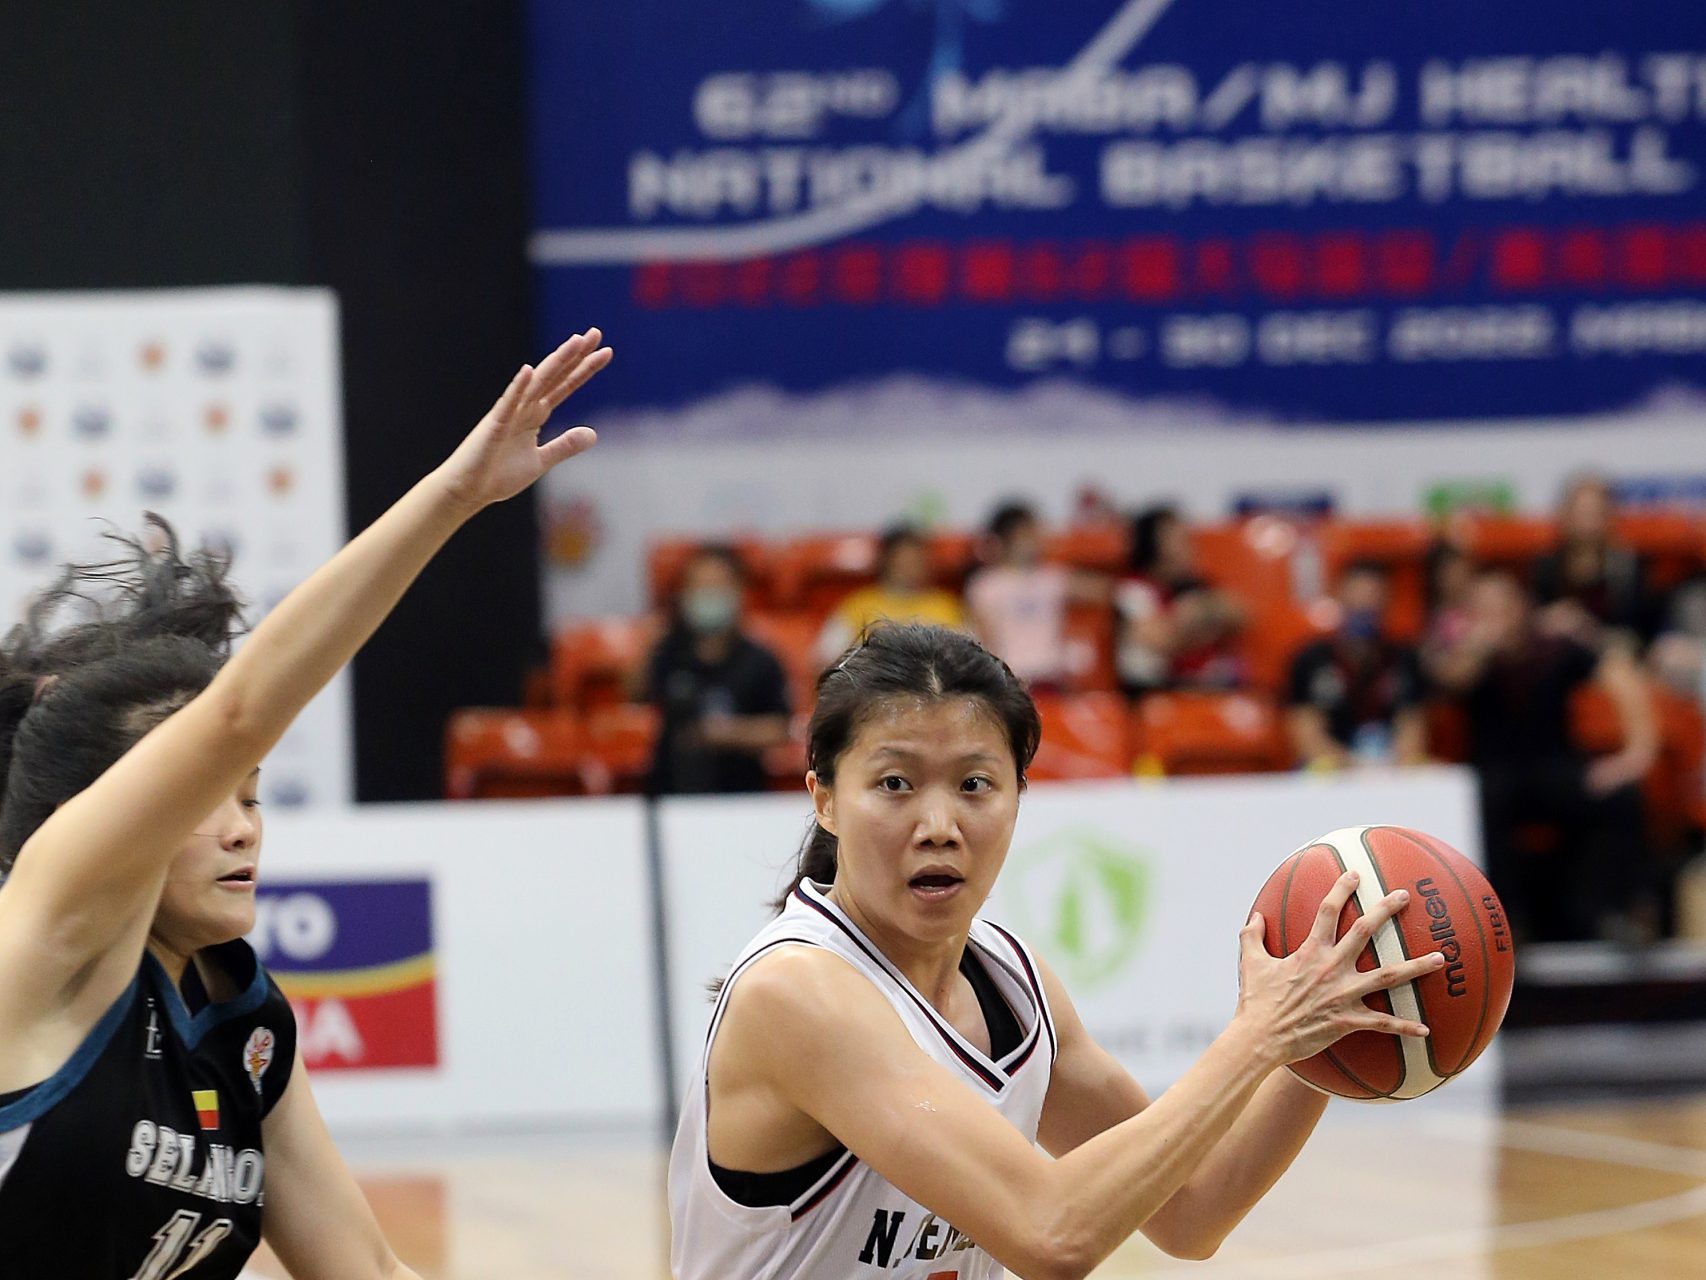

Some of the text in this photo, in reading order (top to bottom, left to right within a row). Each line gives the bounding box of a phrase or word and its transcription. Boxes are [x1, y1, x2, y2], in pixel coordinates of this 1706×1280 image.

[1419, 50, 1706, 124] HEALT
[1100, 124, 1694, 206] BASKETBALL
[1415, 877, 1467, 998] molten
[1481, 895, 1508, 953] FIBA
